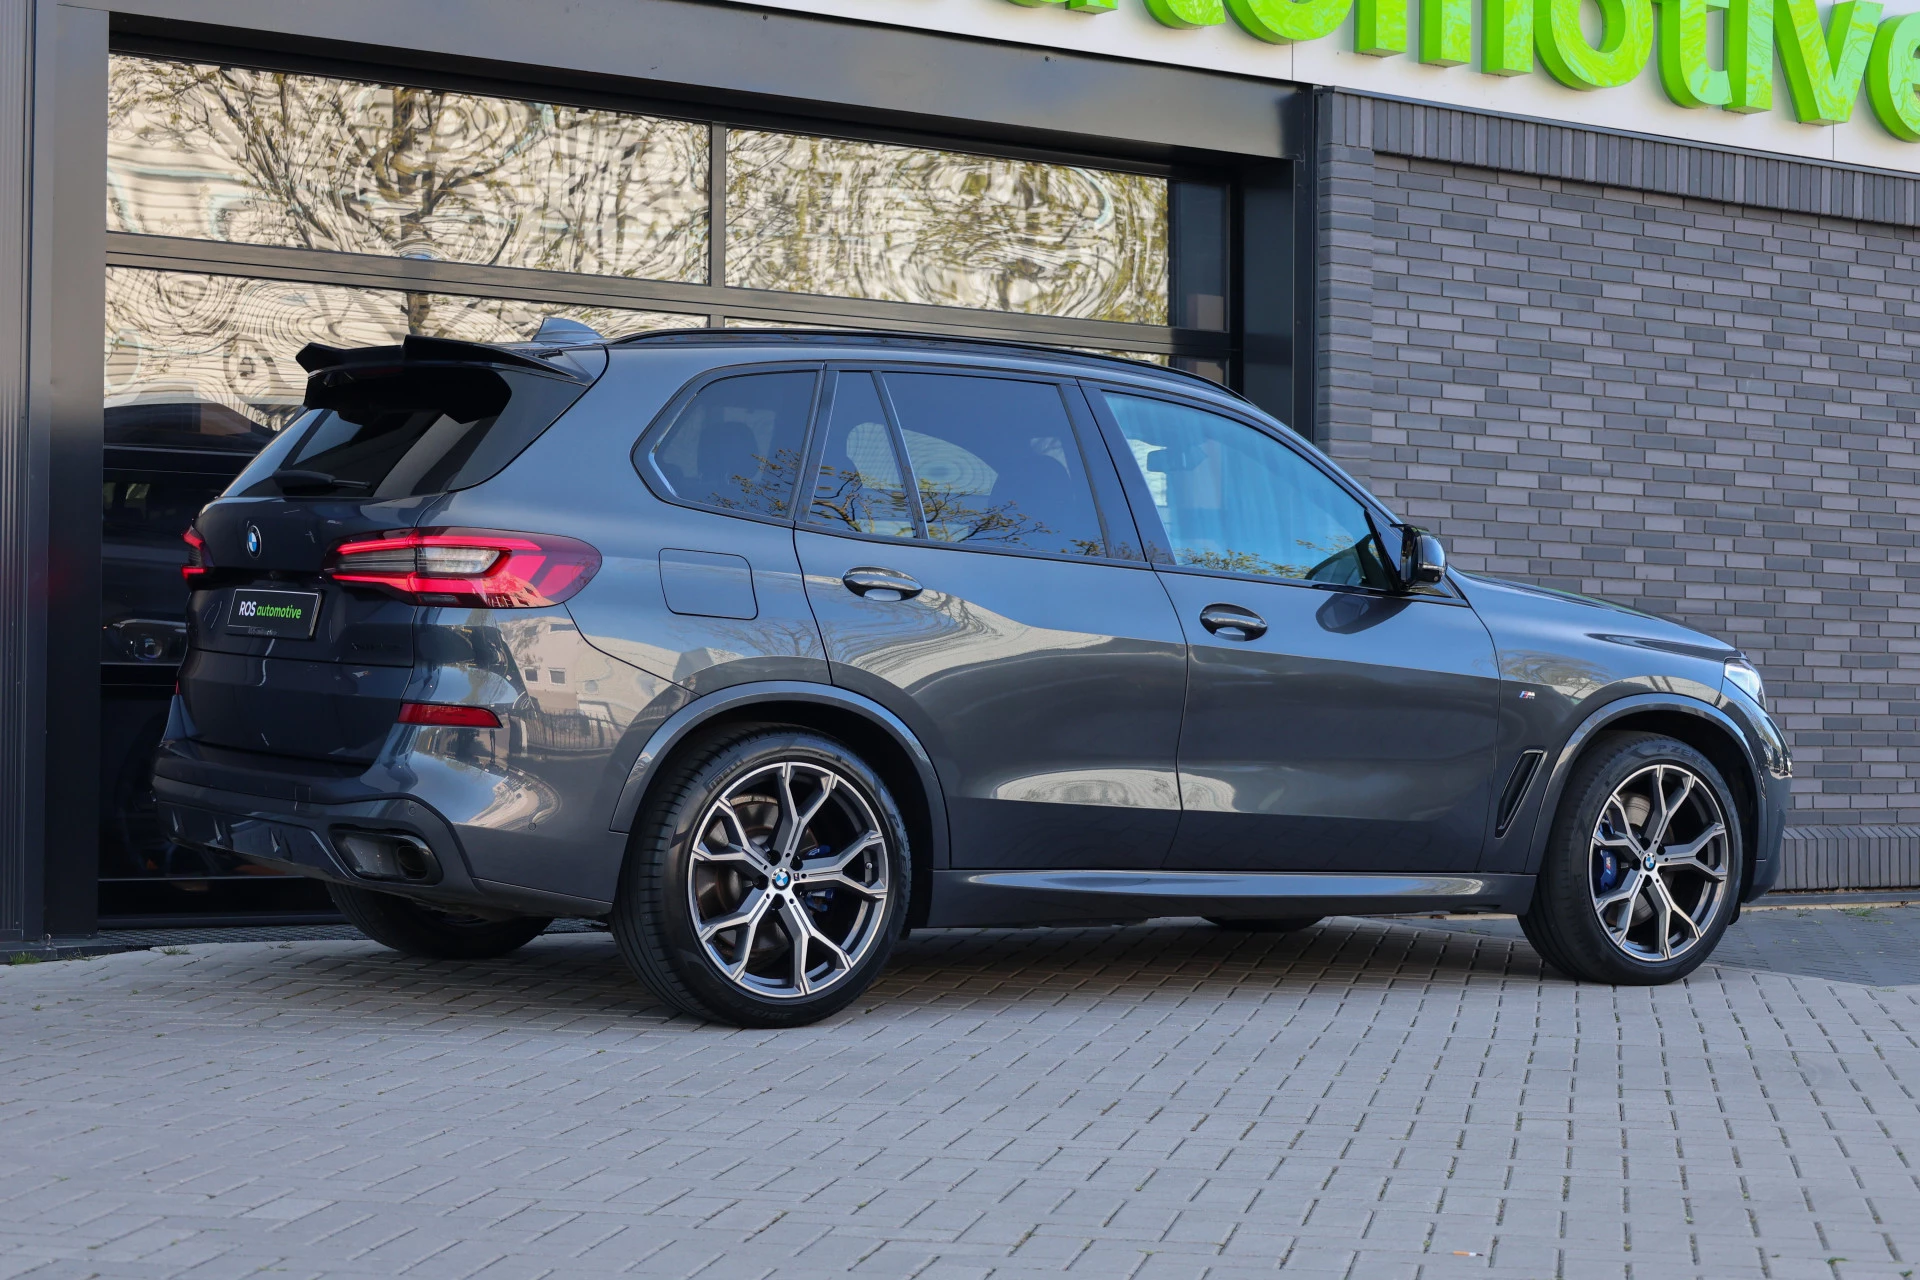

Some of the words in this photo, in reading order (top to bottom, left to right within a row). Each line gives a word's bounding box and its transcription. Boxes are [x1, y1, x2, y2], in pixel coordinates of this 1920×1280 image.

[1008, 0, 1920, 143] motiv
[239, 601, 256, 616] ROS
[256, 603, 301, 619] automotive
